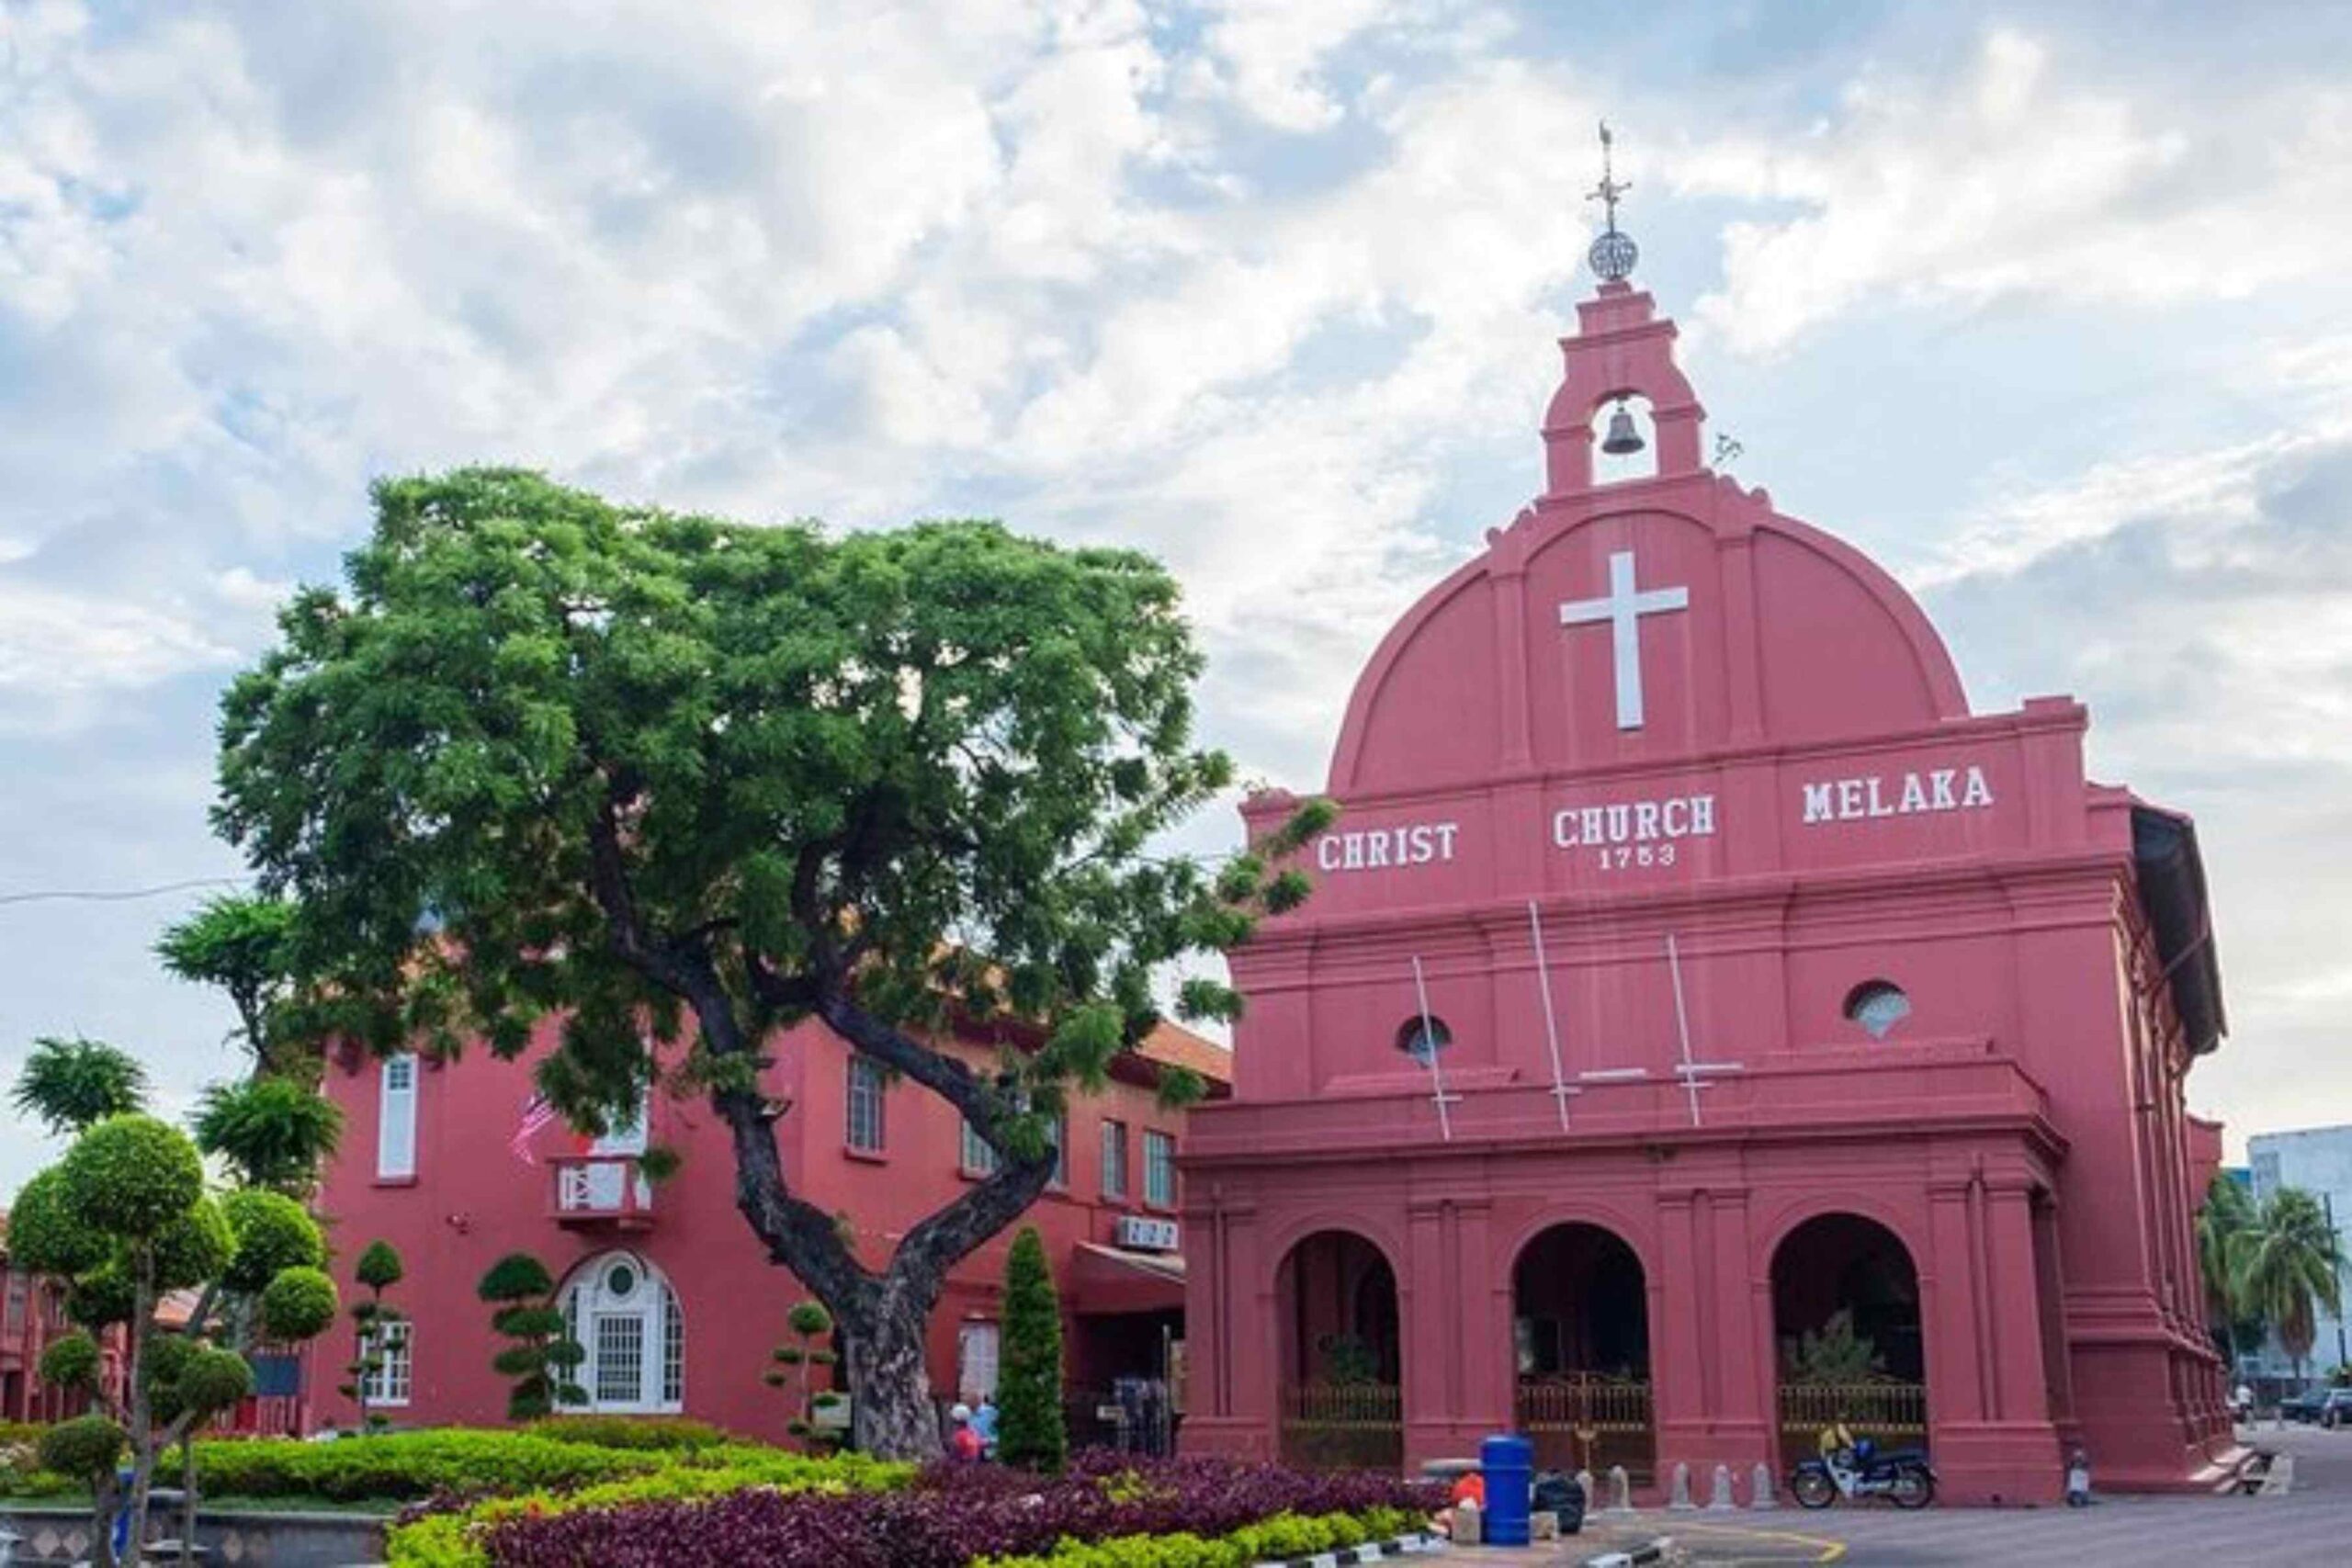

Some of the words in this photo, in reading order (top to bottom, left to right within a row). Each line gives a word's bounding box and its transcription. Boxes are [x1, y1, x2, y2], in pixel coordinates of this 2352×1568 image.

[1318, 824, 1458, 870] CHRIST
[1555, 795, 1716, 847] CHURCH
[1803, 766, 1994, 822] MELAKA
[1600, 843, 1675, 869] 1753
